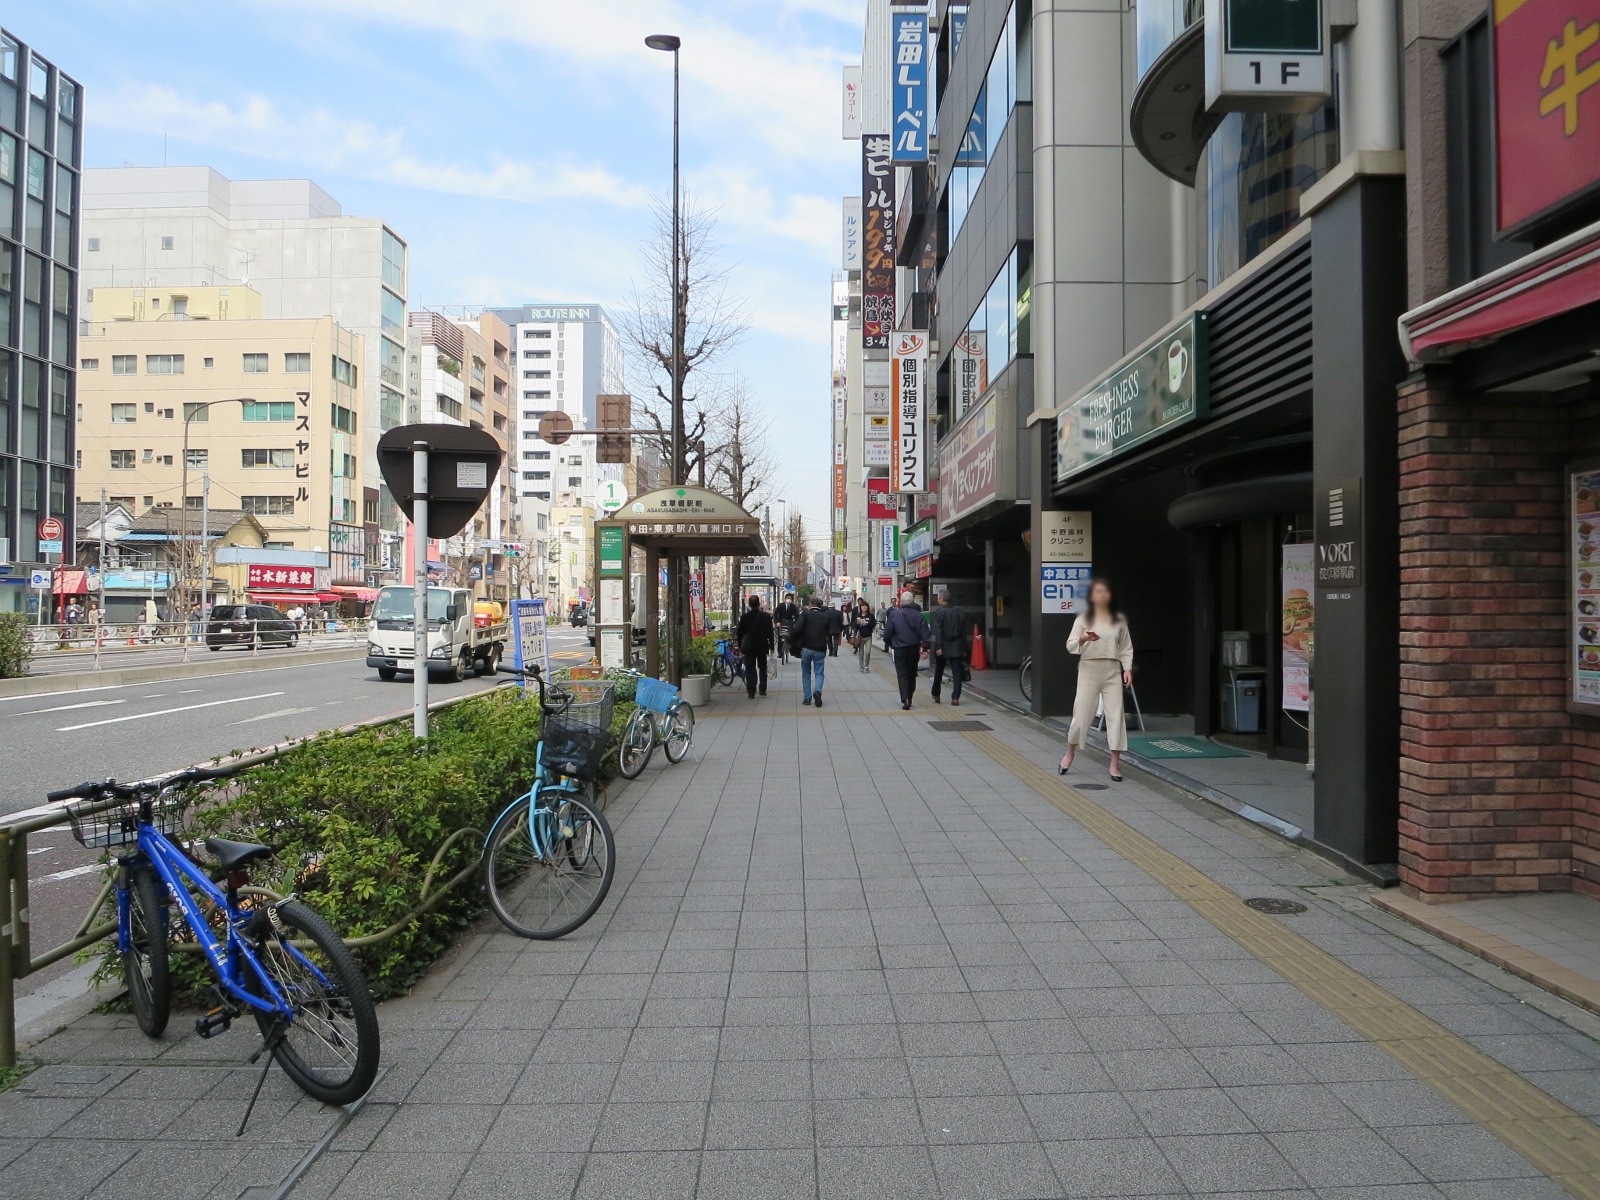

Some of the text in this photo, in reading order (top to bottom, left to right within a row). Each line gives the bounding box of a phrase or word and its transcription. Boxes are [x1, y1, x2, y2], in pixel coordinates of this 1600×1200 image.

[848, 93, 856, 120] ワコール
[897, 21, 923, 151] 岩田レーベル
[866, 138, 891, 208] 生ビール
[847, 216, 857, 260] ルシアン
[883, 209, 893, 253] 中ジョッキ
[532, 309, 589, 319] ROUTE INN
[1089, 370, 1139, 425] FRESHNESS
[902, 358, 917, 488] 個別指導ユリウス
[1095, 407, 1133, 449] BURGER
[296, 392, 310, 501] マスヤビル
[607, 483, 614, 498] 1
[1320, 542, 1355, 562] VORT
[263, 570, 312, 584] 水新菜館
